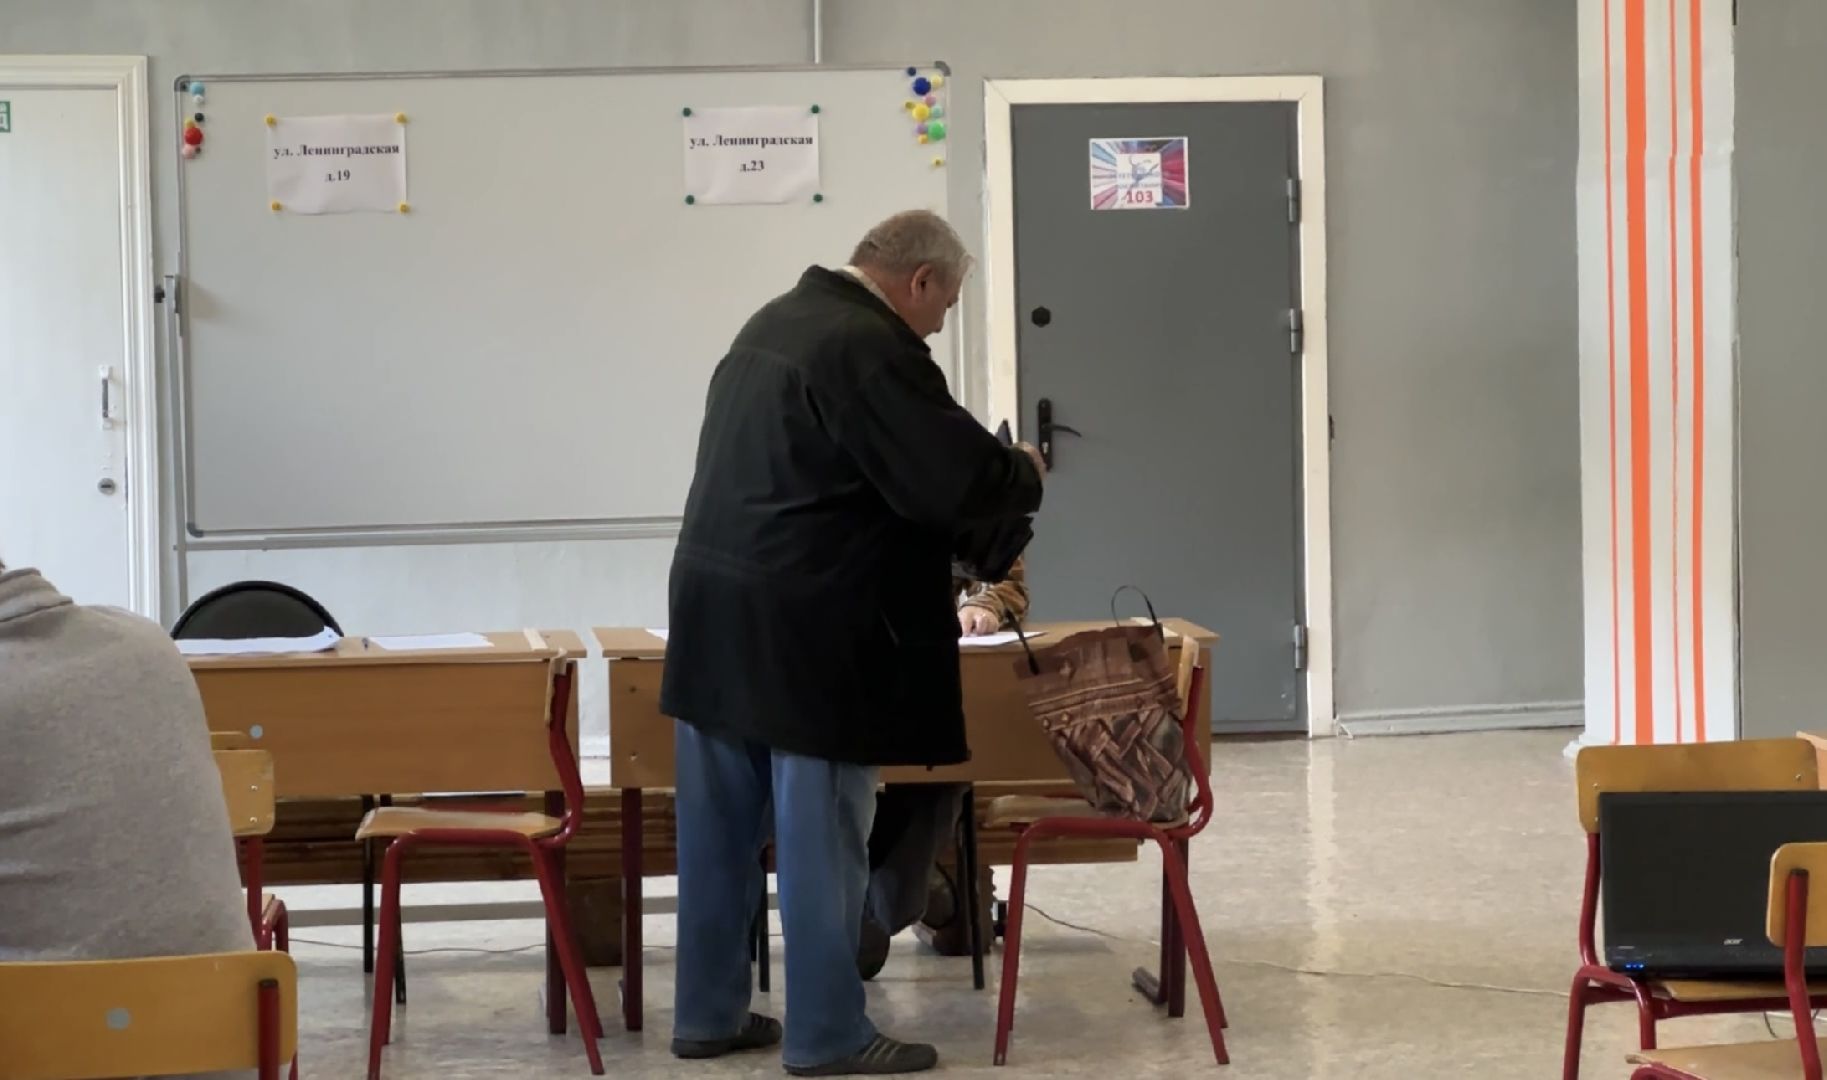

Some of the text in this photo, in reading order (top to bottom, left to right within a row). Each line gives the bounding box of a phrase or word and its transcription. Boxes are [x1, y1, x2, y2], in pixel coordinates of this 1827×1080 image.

[690, 134, 813, 149] ул. Ленинградская
[273, 144, 400, 160] ул. Ленинградская
[739, 160, 765, 172] д.23
[325, 169, 351, 182] д.19
[1126, 190, 1153, 204] 103
